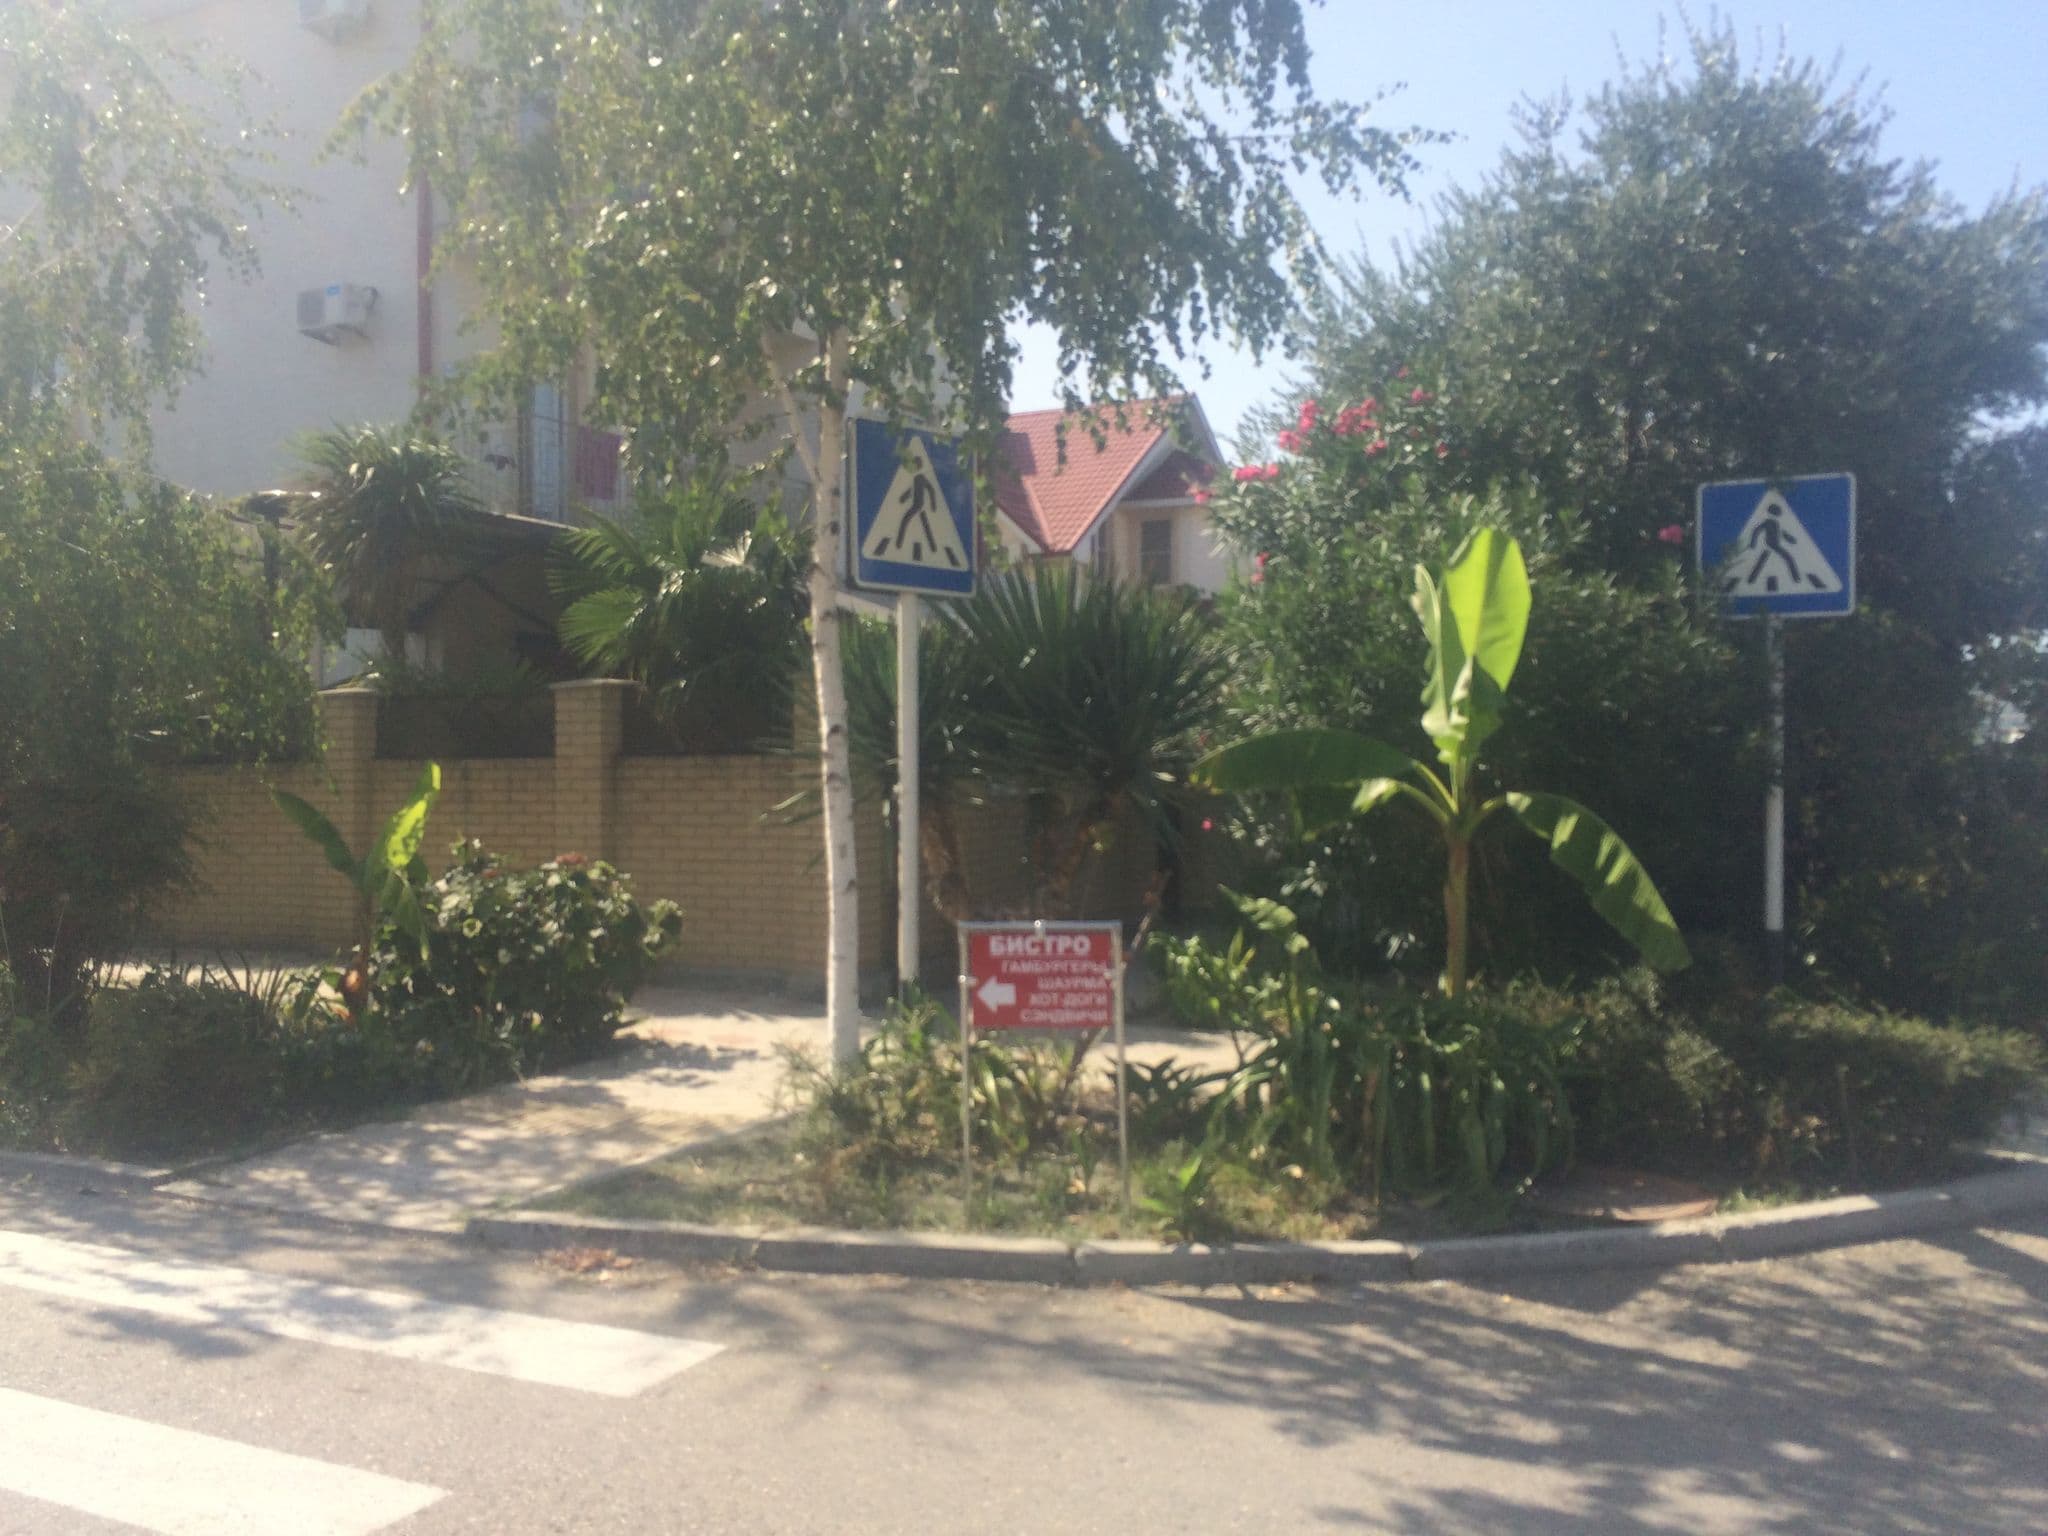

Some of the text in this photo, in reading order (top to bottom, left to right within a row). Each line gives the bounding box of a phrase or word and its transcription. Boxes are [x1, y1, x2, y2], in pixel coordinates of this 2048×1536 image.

[990, 935, 1091, 956] БИСТРО
[1002, 960, 1107, 973] ГАМБУРГЕРЫ
[1038, 977, 1106, 989] ШАУРМА
[1020, 1010, 1107, 1022] СЭНДВИЧИ
